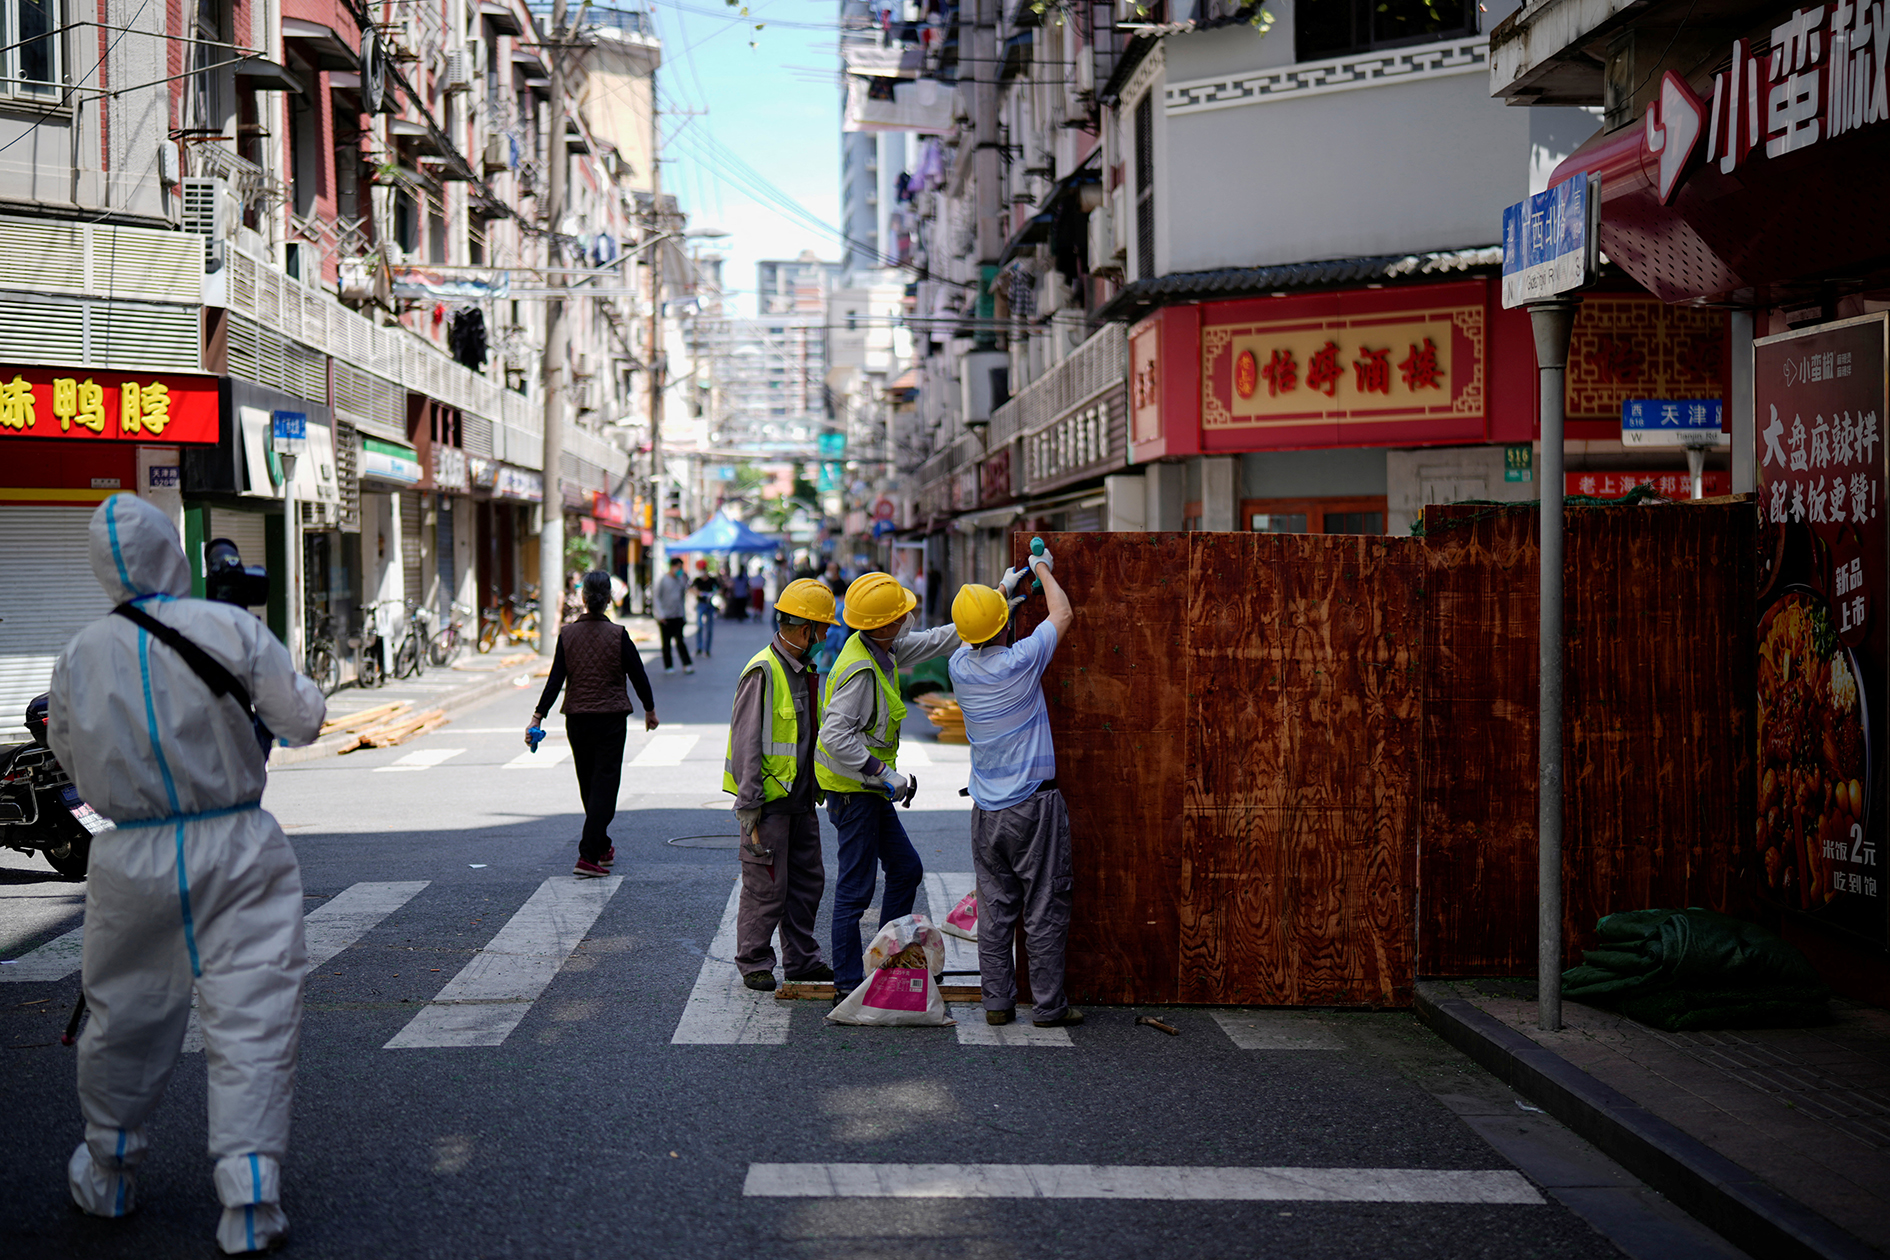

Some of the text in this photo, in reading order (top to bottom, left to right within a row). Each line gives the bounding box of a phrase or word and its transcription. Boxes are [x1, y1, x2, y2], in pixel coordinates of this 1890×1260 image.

[1575, 257, 1581, 278] S
[1507, 281, 1514, 301] N
[1799, 352, 1834, 384] 小蛮椒
[1631, 403, 1643, 417] 西
[1631, 432, 1643, 442] W
[1676, 432, 1717, 442] Tianjin Rd
[1761, 403, 1879, 472] 大盘麻辣拌
[1507, 448, 1529, 463] 516
[1770, 472, 1877, 524] 配米饭更赞!
[1835, 557, 1863, 597] 新品
[1840, 595, 1865, 633] 上市
[1822, 823, 1877, 866] 米饭2元
[1833, 871, 1877, 897] 吃到饱
